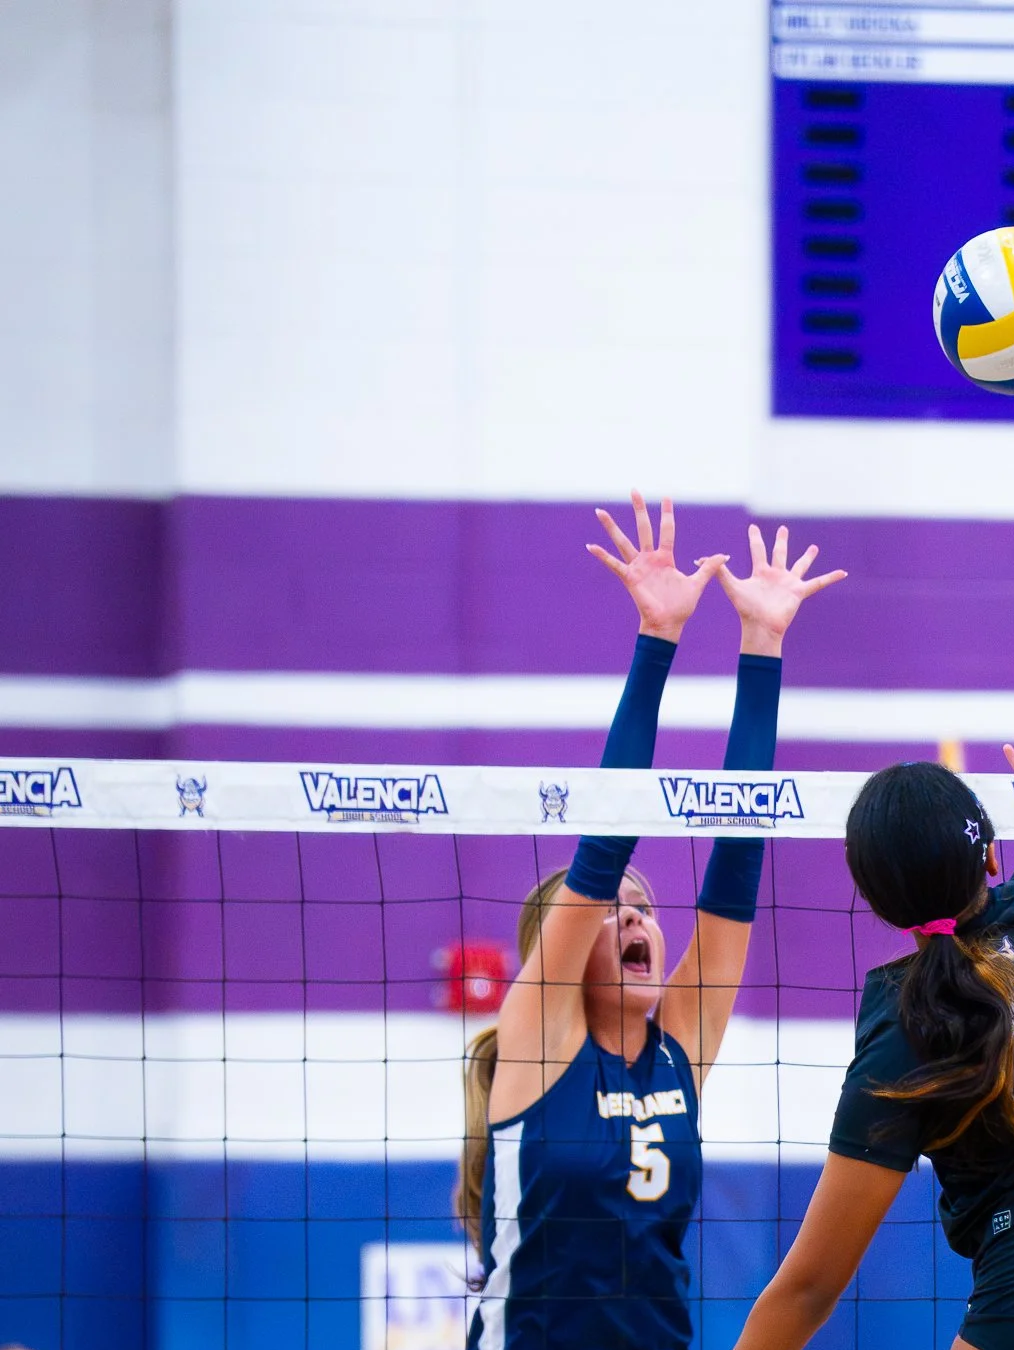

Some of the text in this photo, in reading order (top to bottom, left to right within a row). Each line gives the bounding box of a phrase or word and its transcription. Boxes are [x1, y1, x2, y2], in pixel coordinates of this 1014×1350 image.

[299, 772, 448, 814] VALENCIA
[659, 778, 804, 818] VALENCIA
[700, 816, 760, 825] HIGH SCHOOL
[626, 1122, 671, 1202] 5
